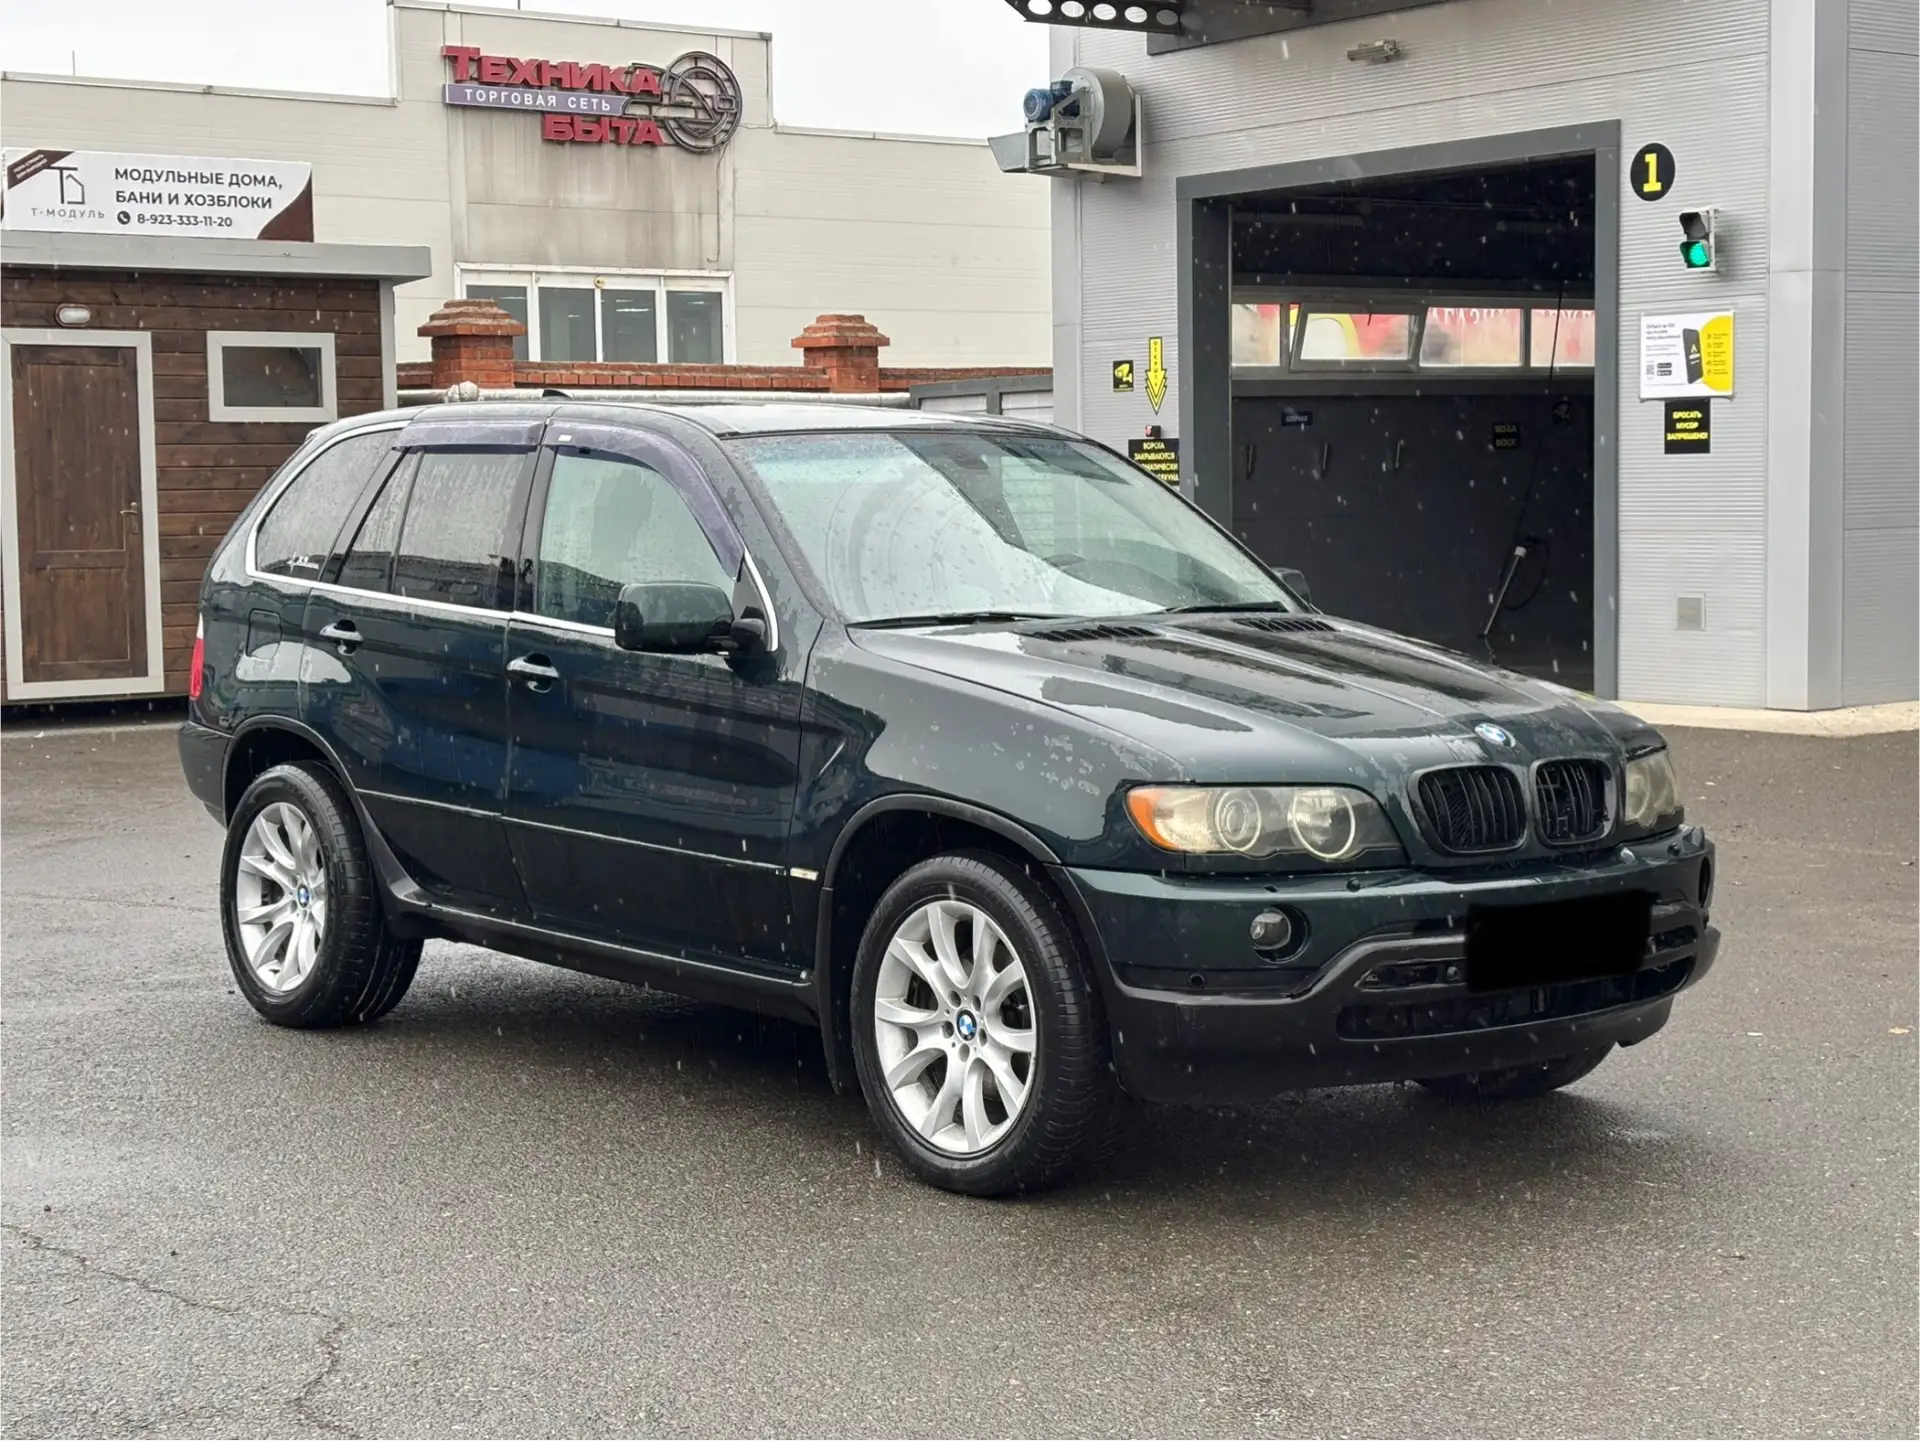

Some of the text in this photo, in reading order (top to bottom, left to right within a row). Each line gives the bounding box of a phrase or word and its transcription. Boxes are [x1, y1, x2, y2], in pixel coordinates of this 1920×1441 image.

[441, 45, 661, 95] ТЕХНИКА
[464, 88, 611, 111] ТОРГОВАЯ СЕТЬ
[543, 114, 665, 146] БЫТА
[114, 167, 283, 190] МОДУЛЬНЫЕ ДОМА,
[1643, 153, 1662, 192] 1
[116, 190, 272, 209] БАНИ И ХОЗБЛОКИ
[31, 207, 105, 220] Т-МОДУЛЬ
[136, 213, 233, 227] 8-923-333-11-20
[1672, 411, 1702, 420] БРОСАТЬ
[1143, 441, 1165, 450] ВОРОТА
[1134, 451, 1175, 461] ЗАКРЫВАЮТСЯ
